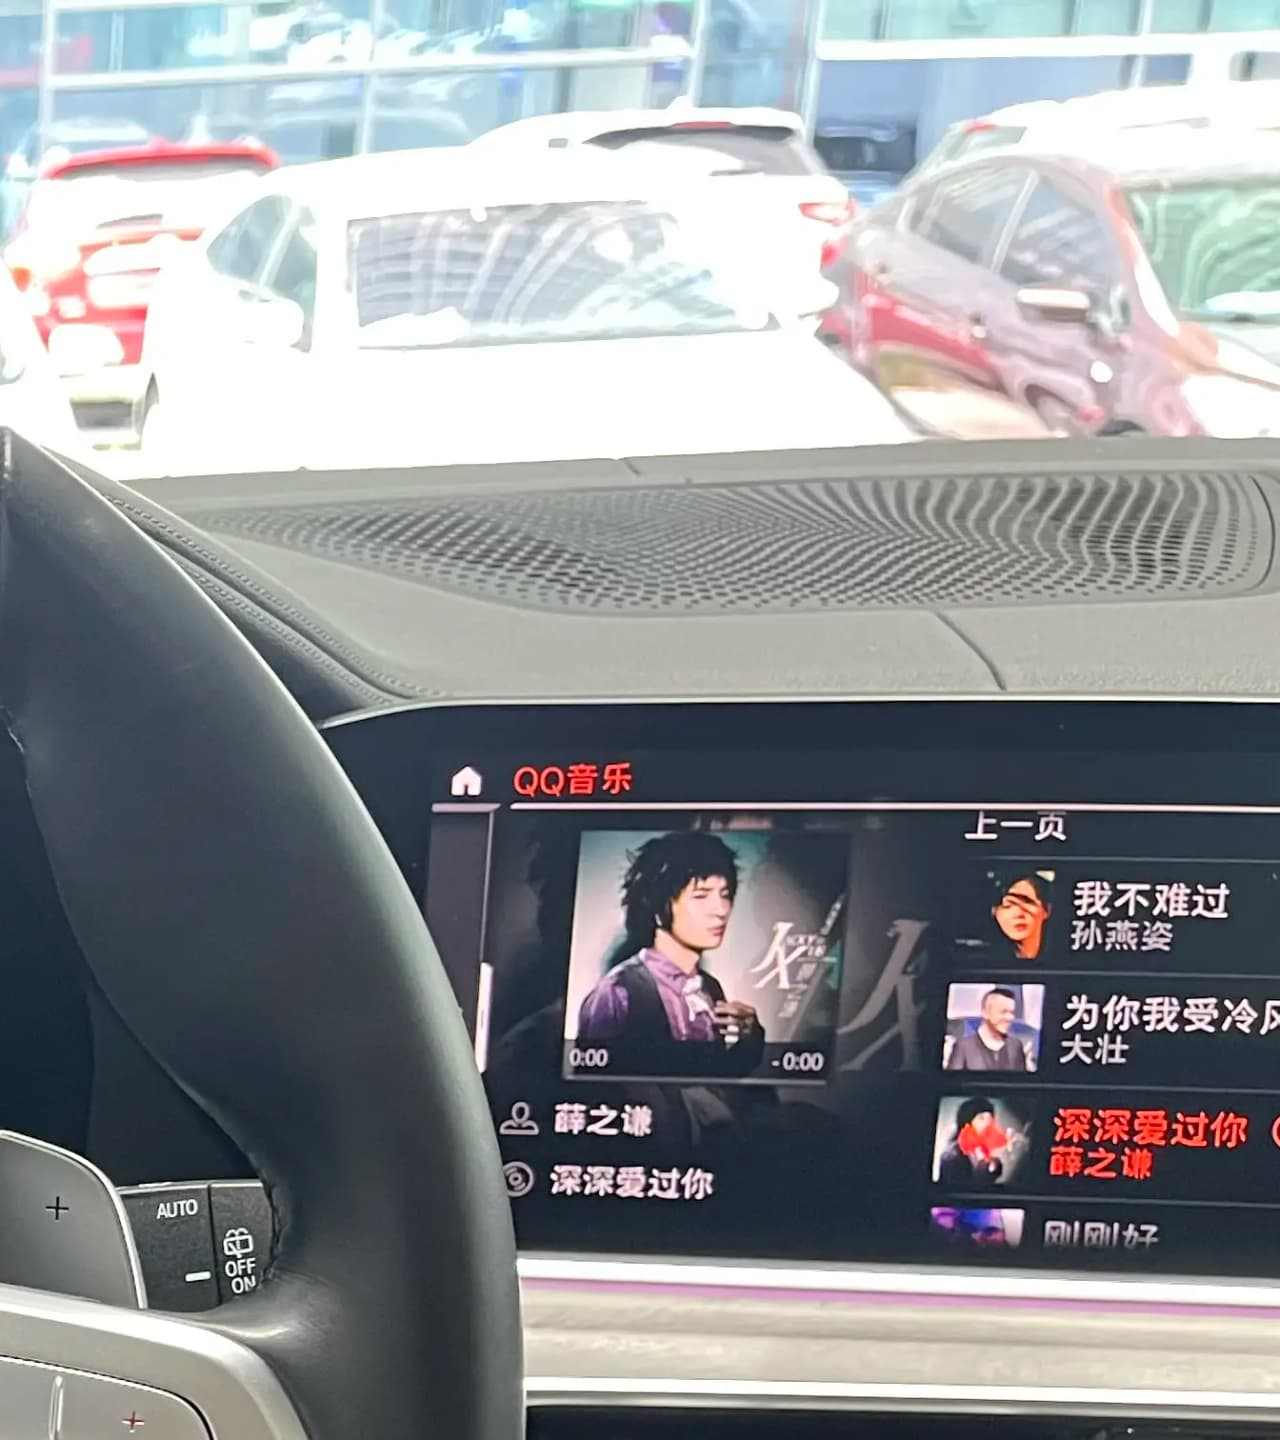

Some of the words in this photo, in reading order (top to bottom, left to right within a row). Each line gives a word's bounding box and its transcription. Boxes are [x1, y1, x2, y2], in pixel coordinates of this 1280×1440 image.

[513, 762, 633, 797] QQ音乐
[964, 811, 1067, 841] 上一页
[1073, 881, 1230, 919] 我不难过
[1071, 920, 1174, 952] 孙燕姿
[569, 1049, 608, 1068] 0:00
[1059, 1033, 1130, 1065] 大壮
[554, 1103, 653, 1137] 薛之谦
[1049, 1146, 1154, 1179] 薛之谦
[550, 1164, 714, 1200] 深深爱过你
[156, 1199, 199, 1219] AUTO
[225, 1258, 256, 1277] OFF
[231, 1275, 256, 1293] ON
